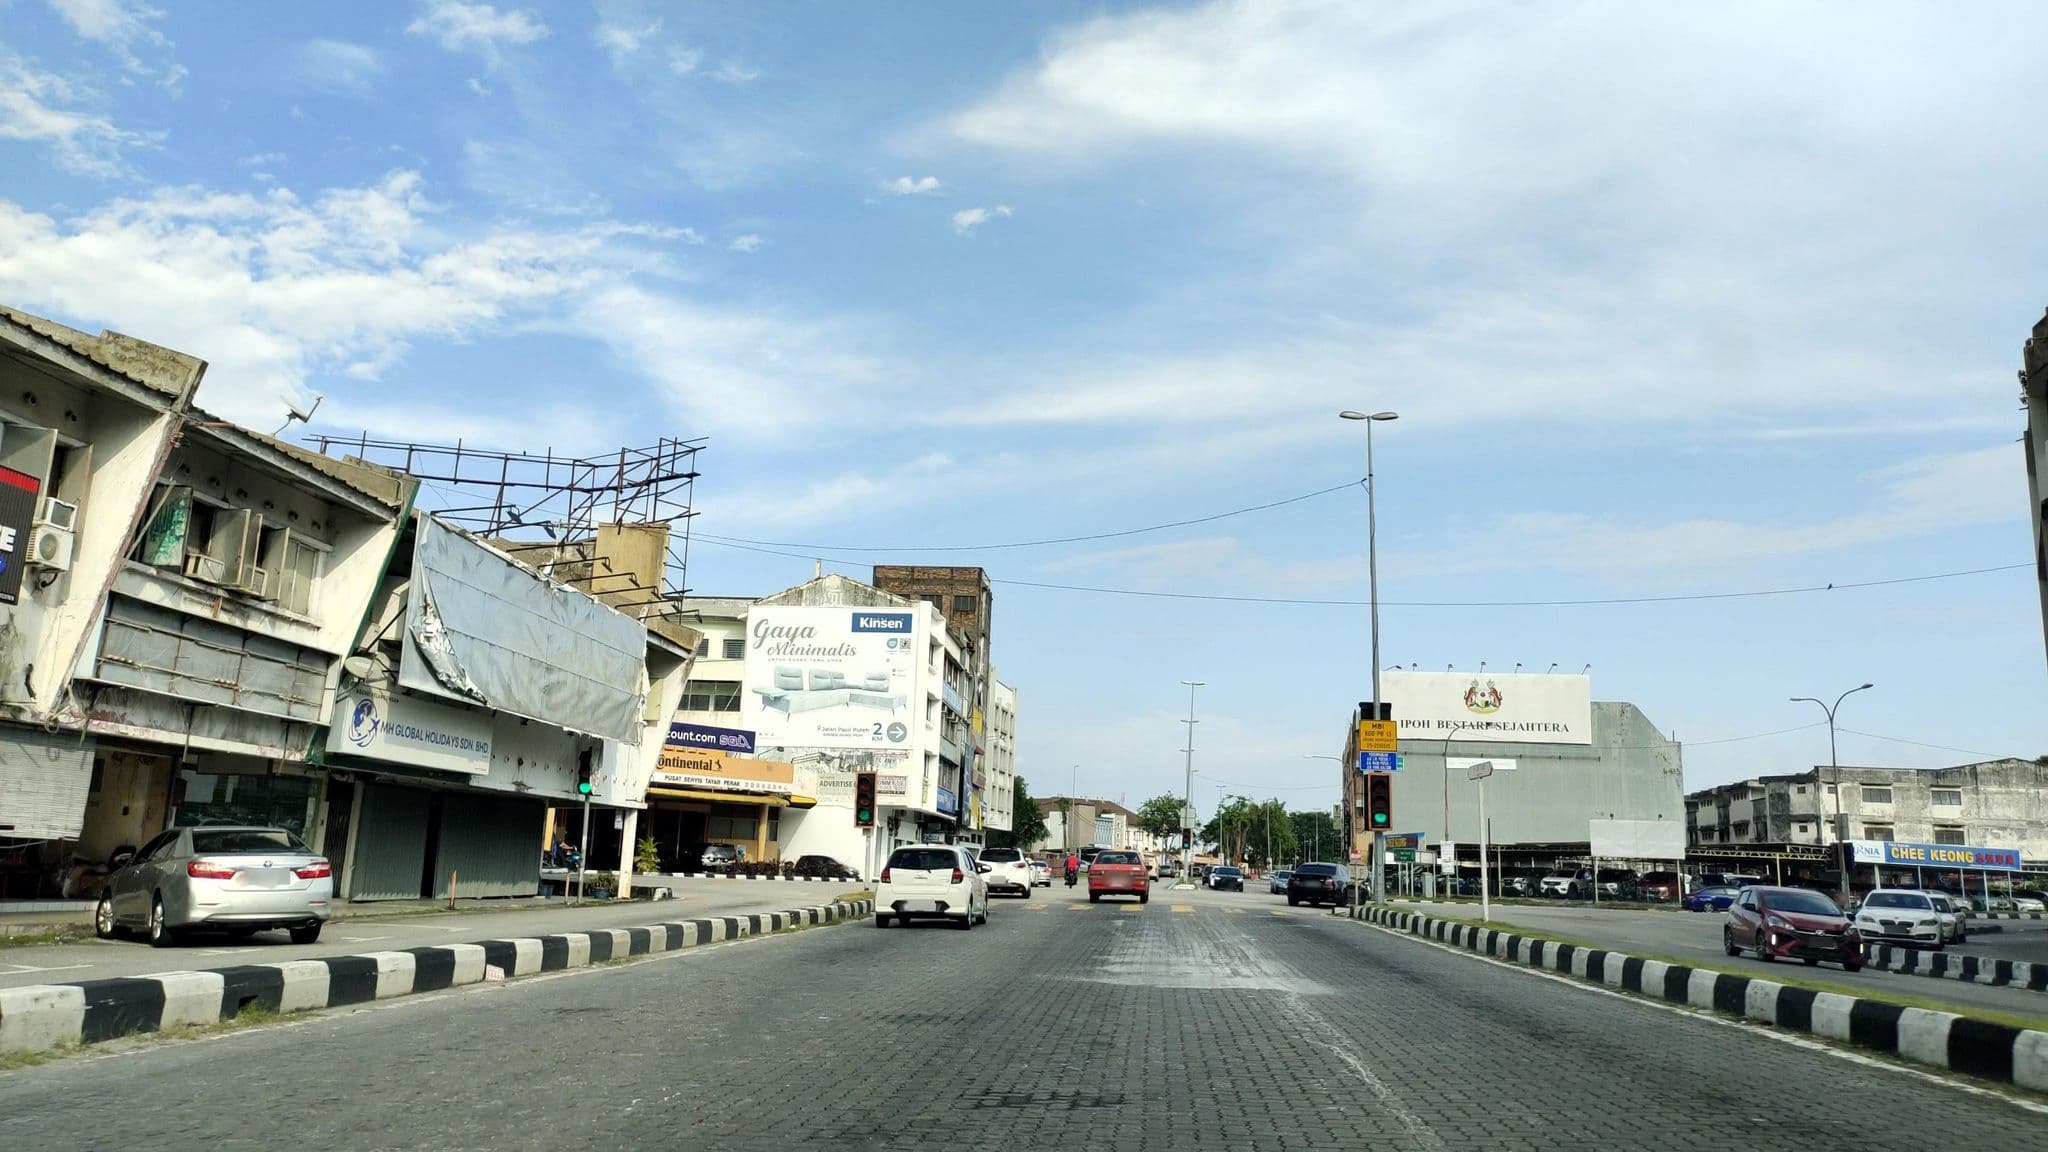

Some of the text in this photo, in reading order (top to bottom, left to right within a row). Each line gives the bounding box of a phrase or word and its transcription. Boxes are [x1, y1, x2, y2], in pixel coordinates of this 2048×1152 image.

[859, 617, 903, 629] Kinsen
[753, 619, 816, 650] Gaya
[767, 641, 857, 657] Minimalis
[873, 722, 883, 736] 2
[1400, 720, 1430, 729] IPOH
[1495, 721, 1569, 733] SEJAHTERA
[381, 721, 490, 754] MH GLOBAL HOLIDAYS SDN. BHD.
[684, 776, 703, 784] SERVIS
[724, 779, 740, 787] PERAK
[819, 779, 853, 788] ADVERTISE
[1891, 847, 1926, 860] CHEE
[1930, 849, 1975, 863] KEONG
